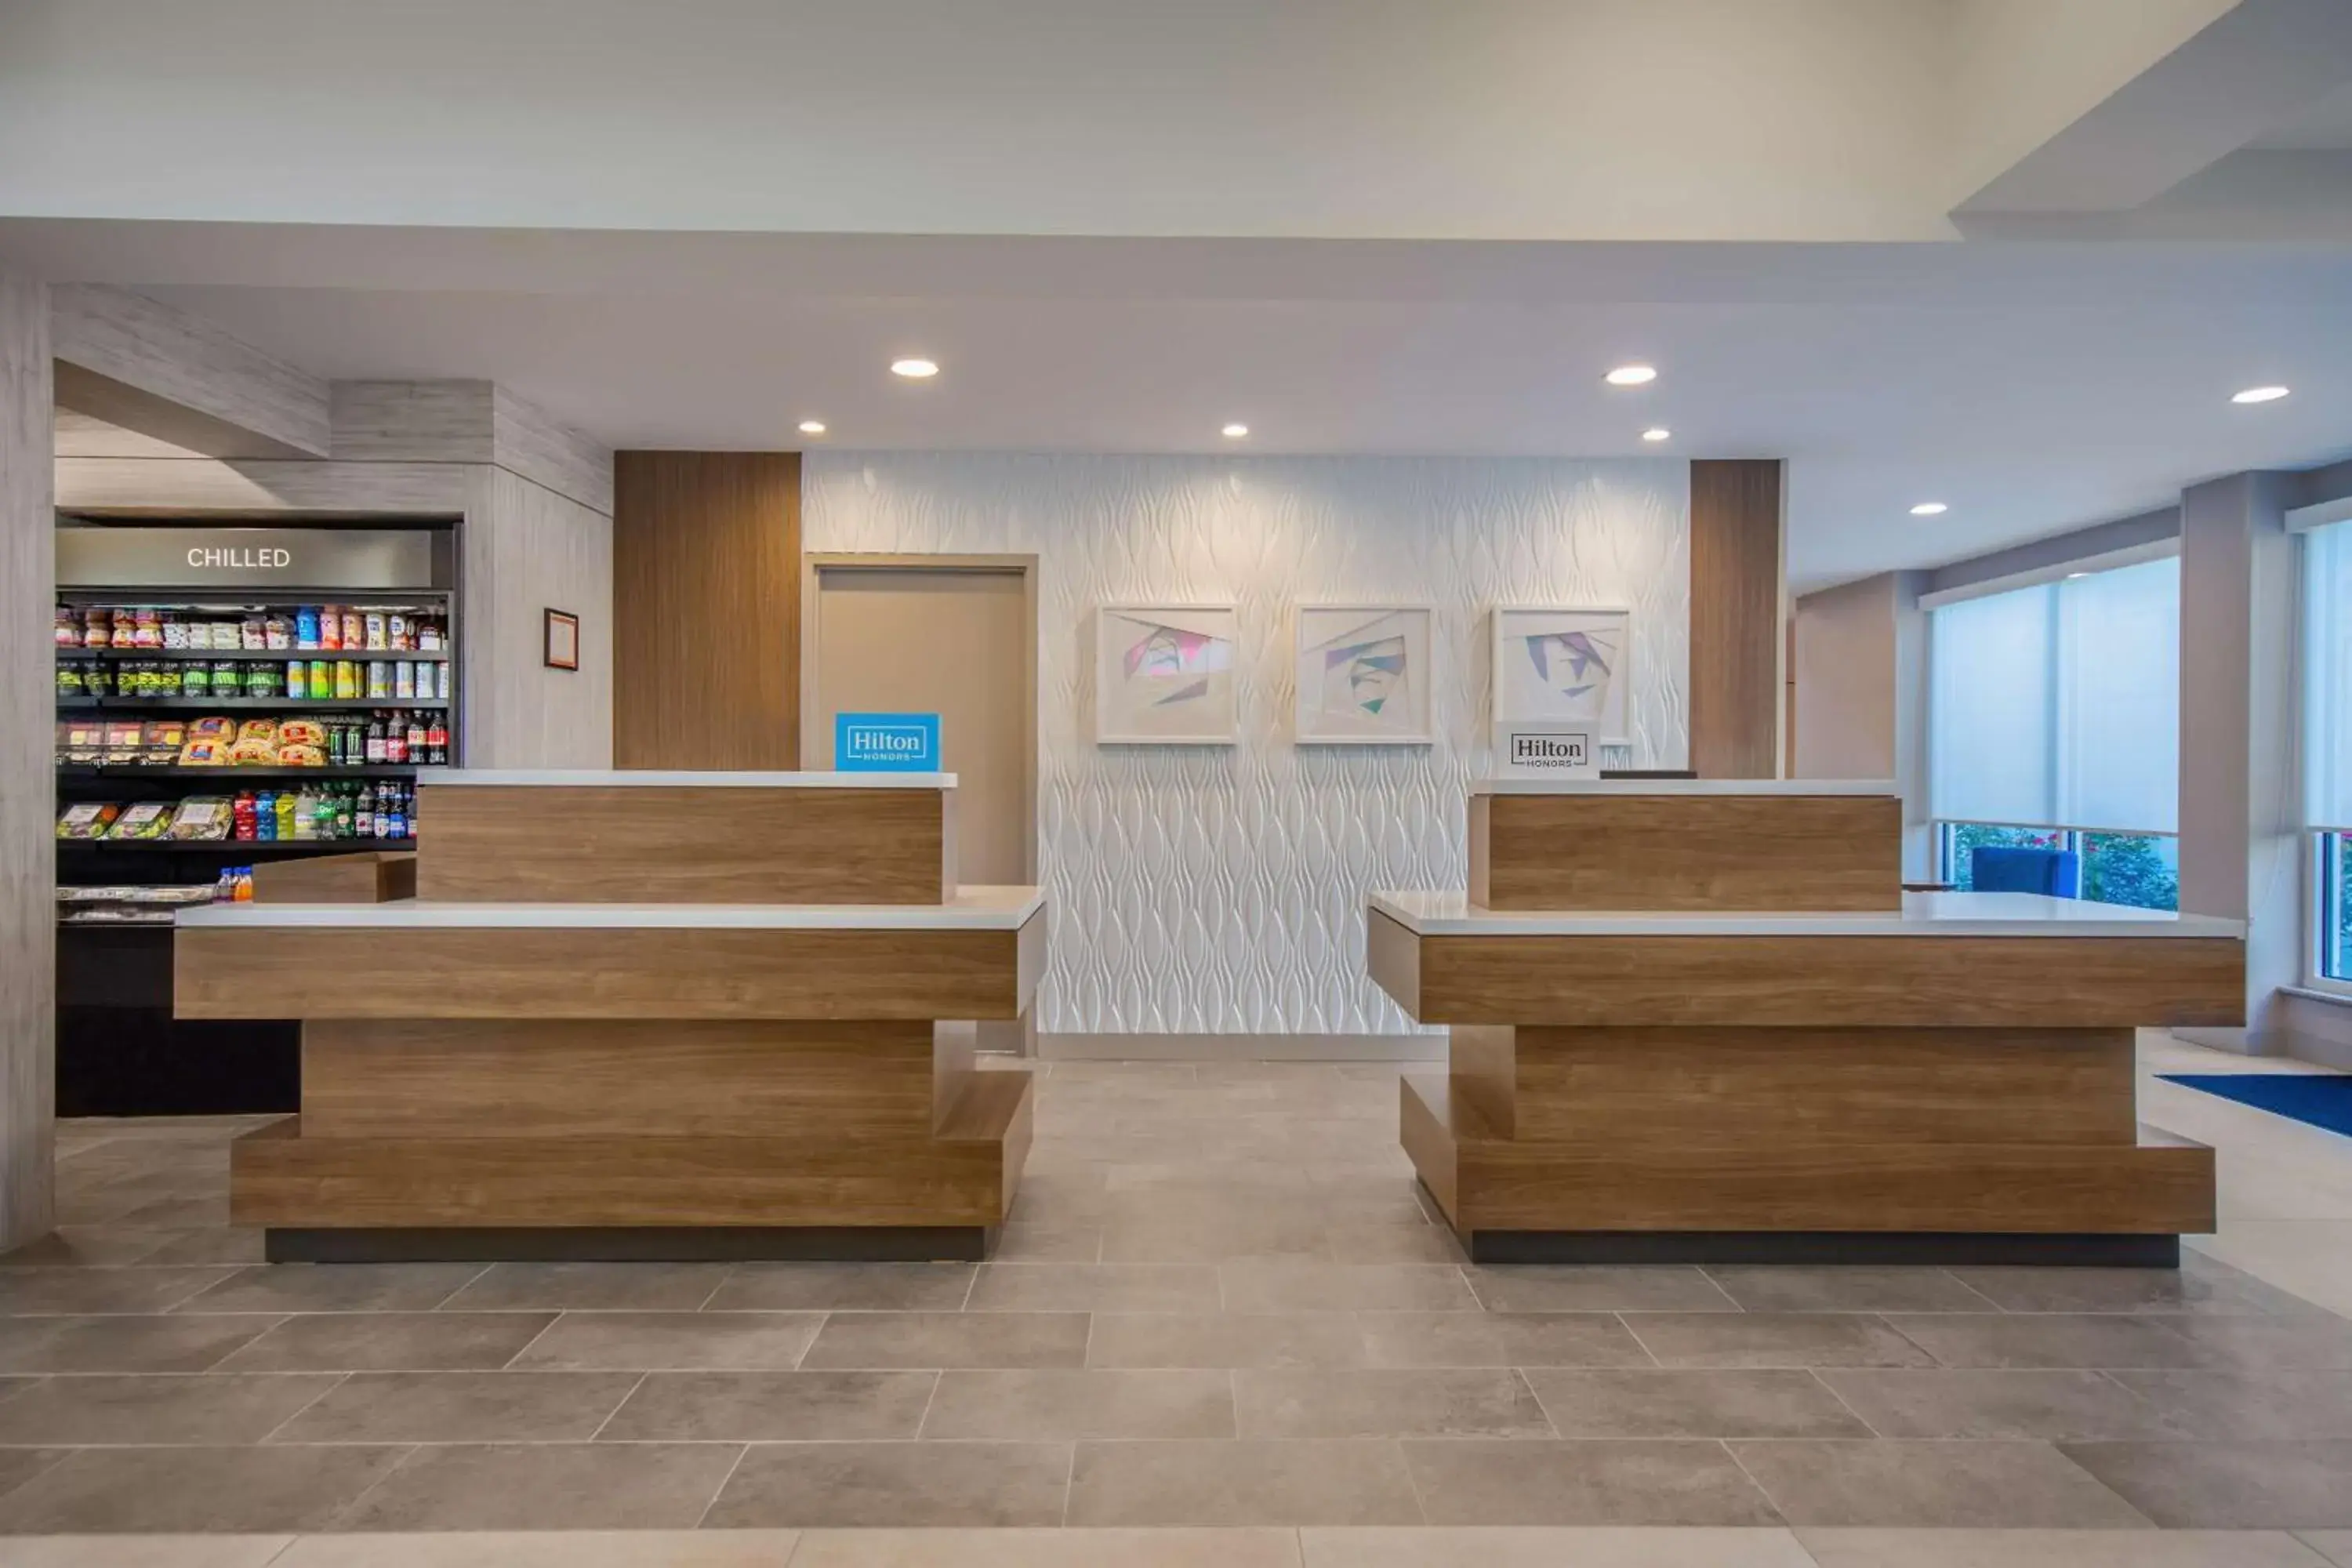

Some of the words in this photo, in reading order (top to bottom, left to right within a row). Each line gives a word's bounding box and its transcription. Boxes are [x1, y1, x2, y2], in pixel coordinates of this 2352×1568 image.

[187, 548, 290, 568] CHILLED
[855, 731, 919, 750] Hilton
[1518, 739, 1581, 757] Hilton
[863, 753, 909, 761] HONORS
